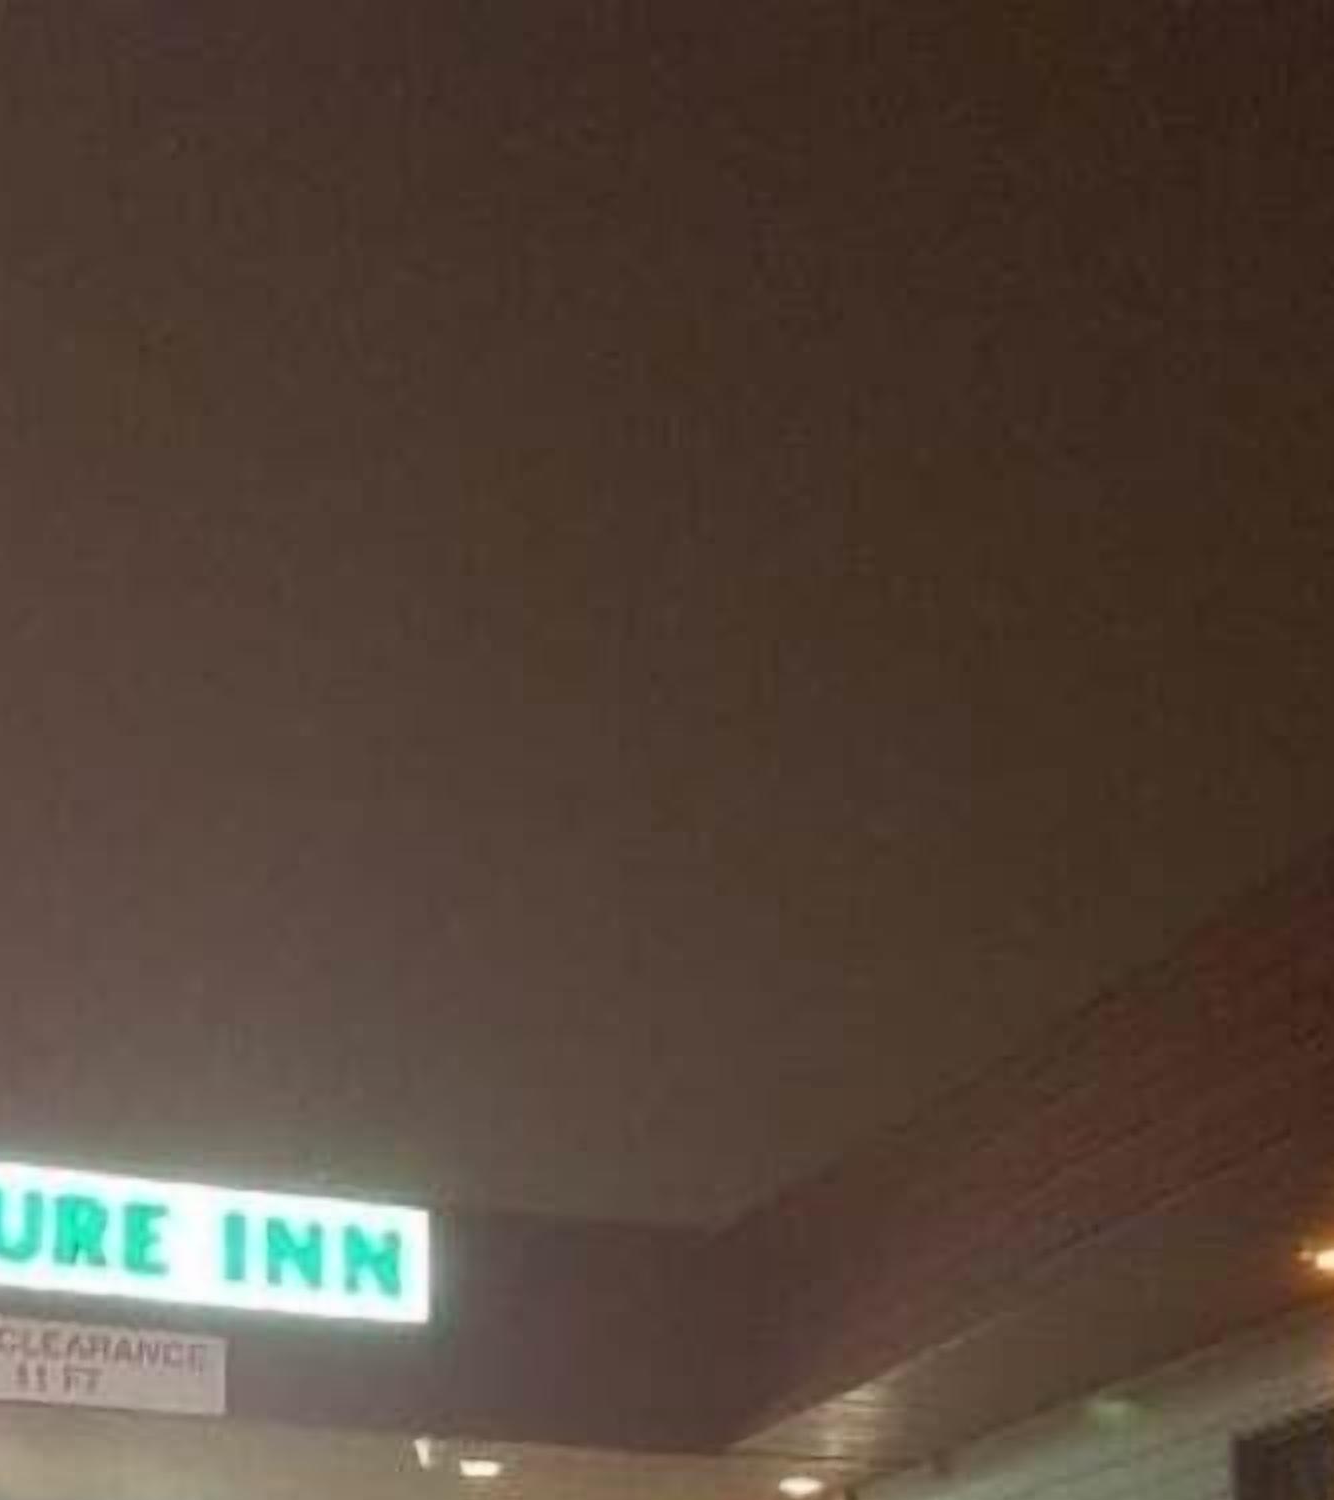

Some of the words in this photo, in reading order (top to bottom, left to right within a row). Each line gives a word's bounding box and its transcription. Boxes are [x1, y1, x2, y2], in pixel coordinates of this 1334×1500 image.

[223, 1212, 403, 1297] INN
[17, 1361, 48, 1393] 11
[63, 1366, 104, 1394] FT
